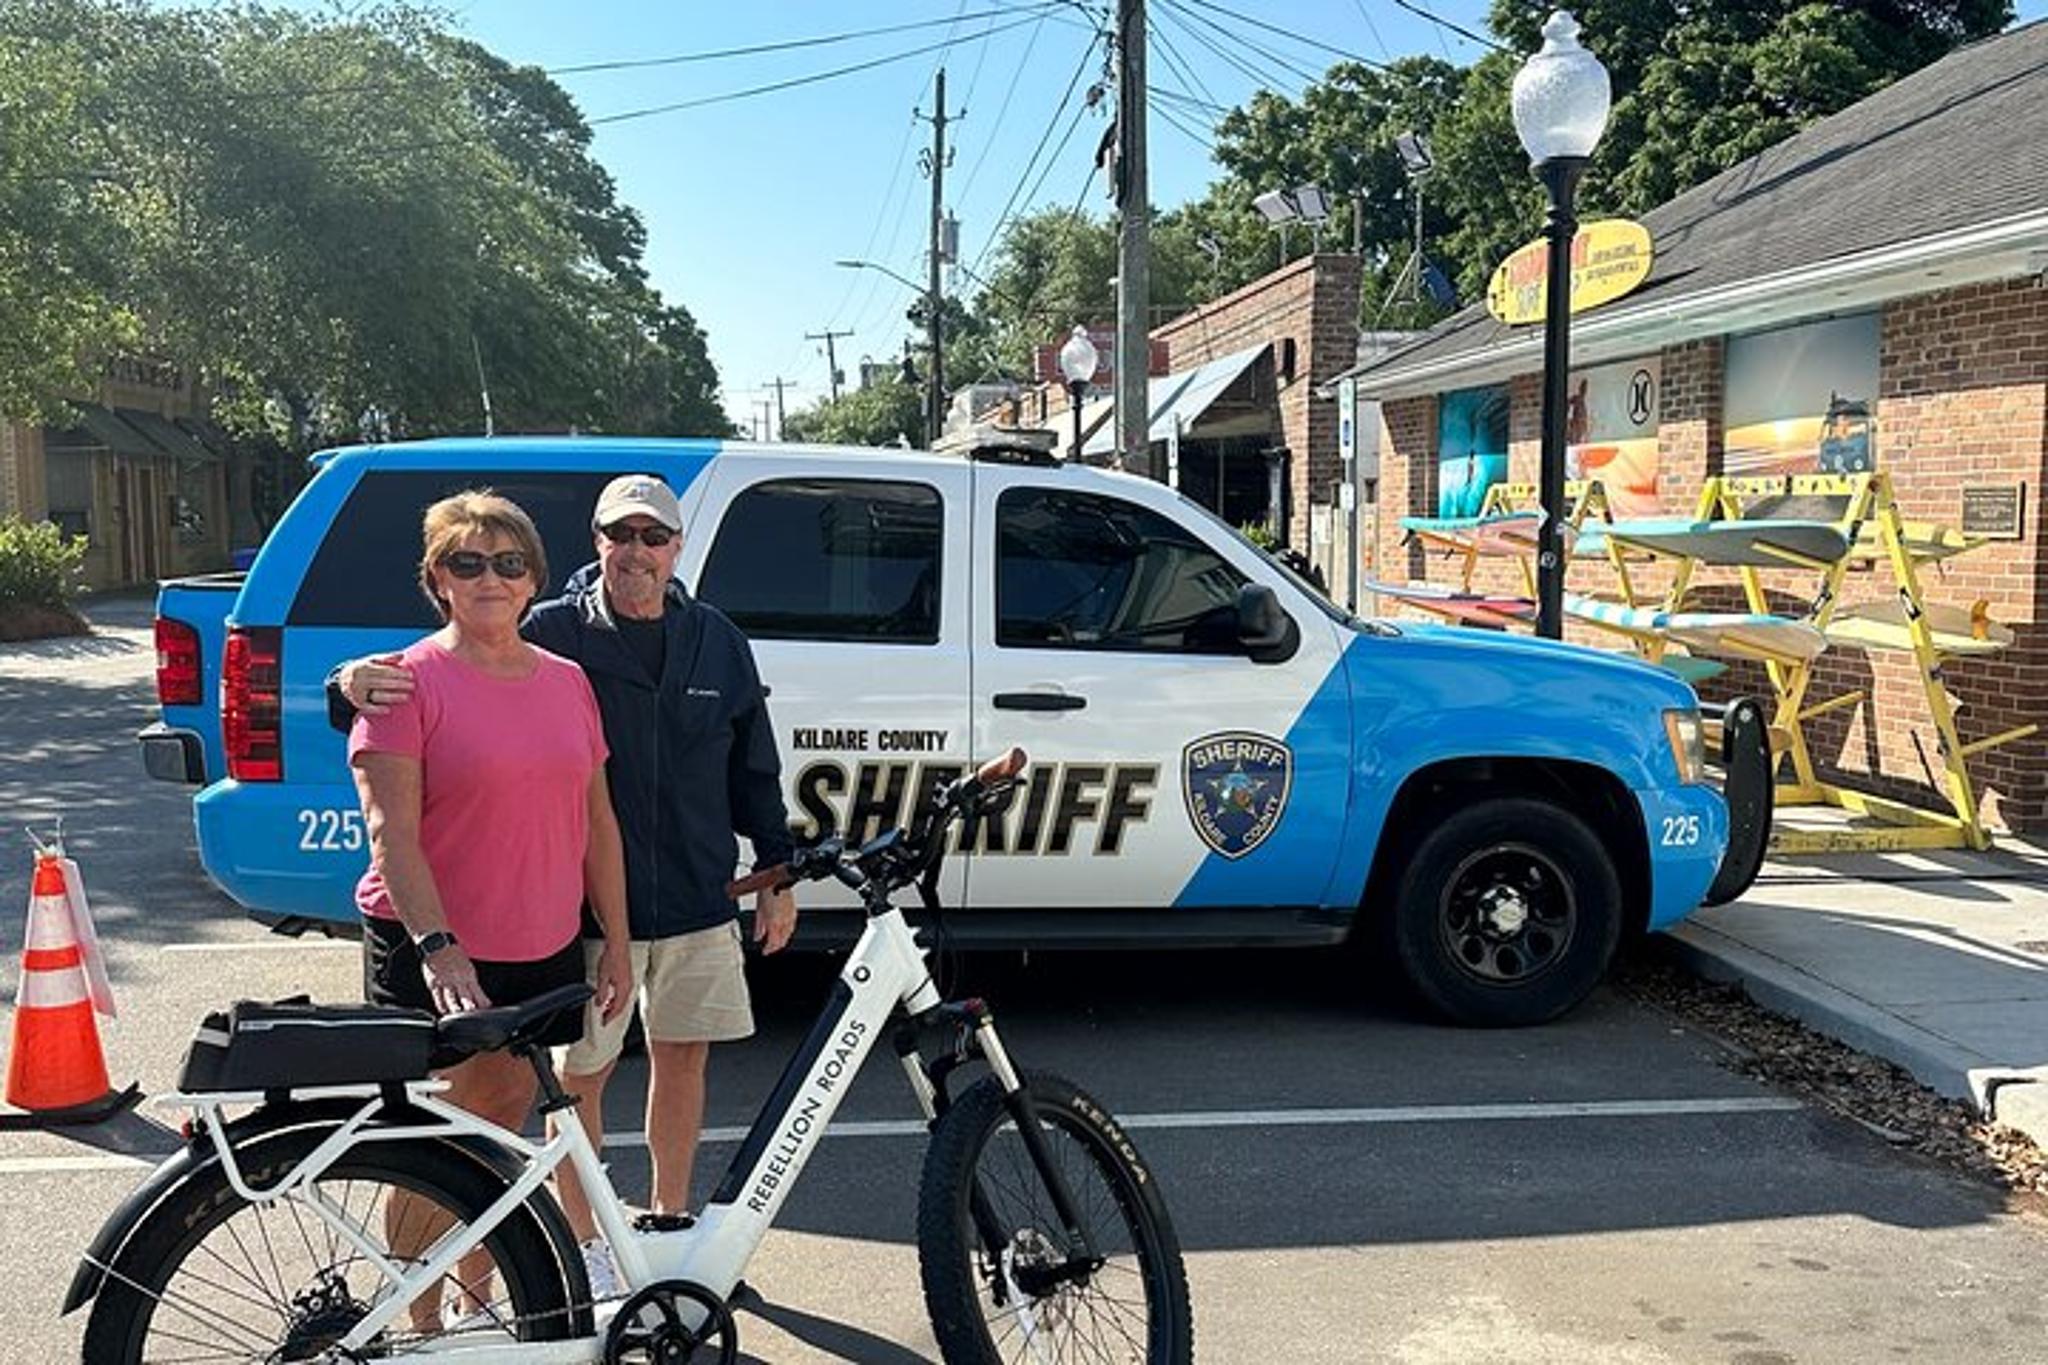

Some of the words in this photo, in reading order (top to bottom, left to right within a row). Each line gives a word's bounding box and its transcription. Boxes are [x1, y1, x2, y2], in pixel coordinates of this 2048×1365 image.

[793, 728, 869, 751] KILDARE
[878, 730, 949, 751] COUNTY
[1193, 741, 1285, 769] SHERIFF
[298, 808, 362, 851] 225
[1661, 815, 1700, 846] 225
[747, 1097, 823, 1214] REBELLION
[816, 1019, 867, 1093] ROADS
[1071, 1096, 1147, 1185] KENDA
